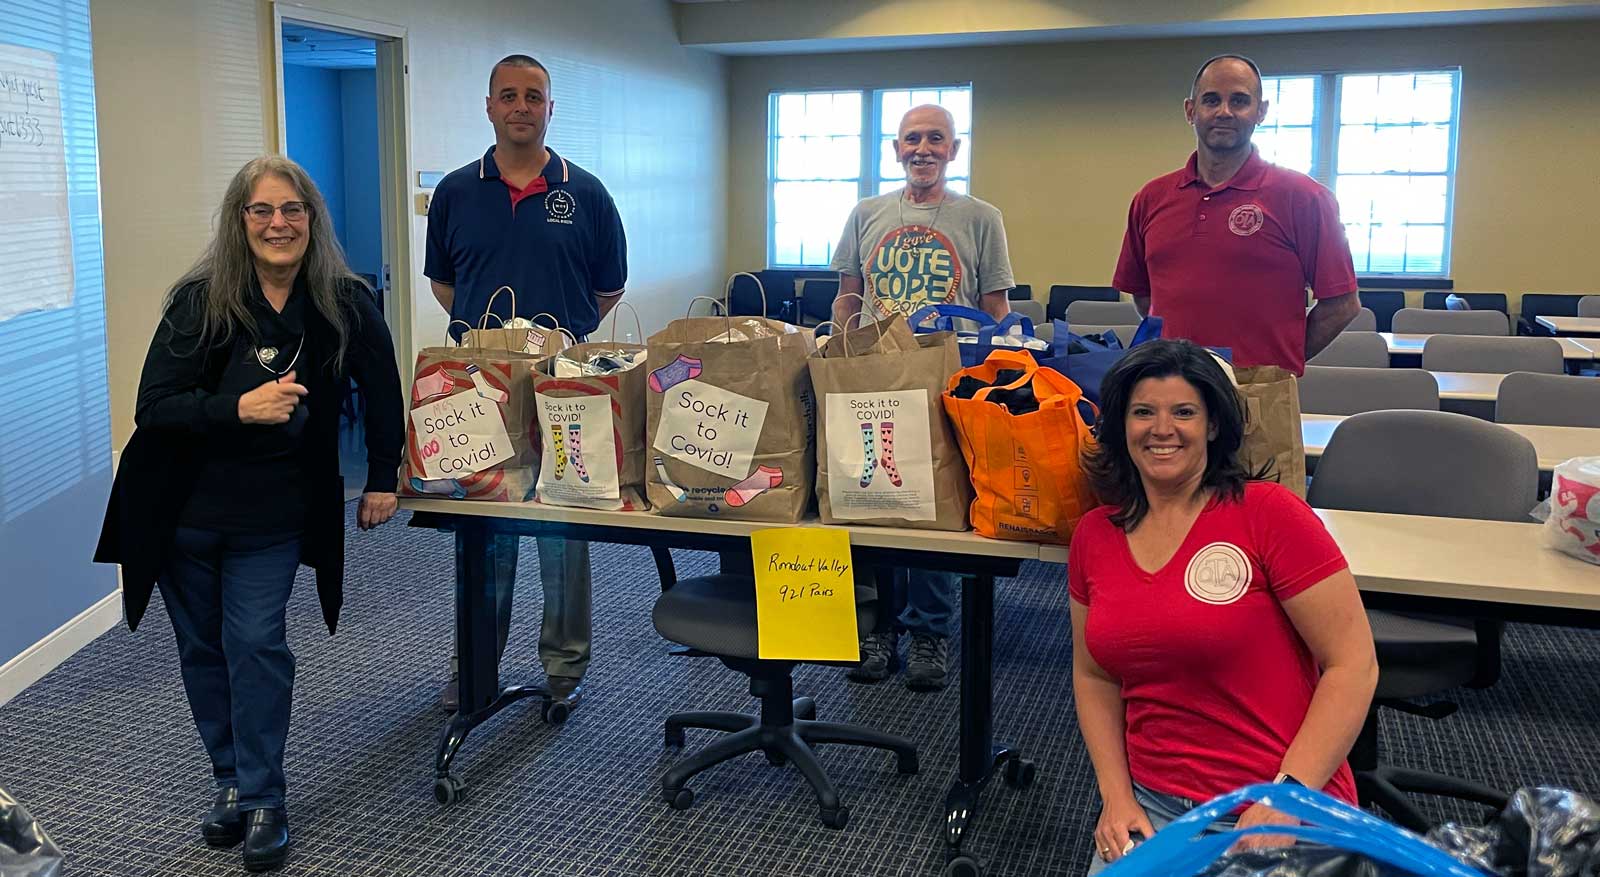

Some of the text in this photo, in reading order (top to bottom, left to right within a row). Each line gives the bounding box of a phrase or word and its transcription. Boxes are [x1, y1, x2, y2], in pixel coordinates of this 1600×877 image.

[894, 233, 900, 248] I
[877, 246, 951, 276] VOTE
[875, 274, 949, 302] COPE
[545, 401, 586, 411] Sock it to
[679, 391, 749, 428] Sock it
[850, 399, 900, 409] Sock it to
[424, 402, 486, 434] Sock it
[549, 413, 581, 422] COVID!
[856, 410, 895, 420] COVID!
[448, 434, 469, 448] to
[697, 422, 717, 441] to
[439, 442, 497, 474] Covid!
[671, 435, 733, 469] Covid!
[818, 558, 848, 577] Valley
[1197, 558, 1237, 588] OTA
[779, 582, 834, 602] 921 Pairs
